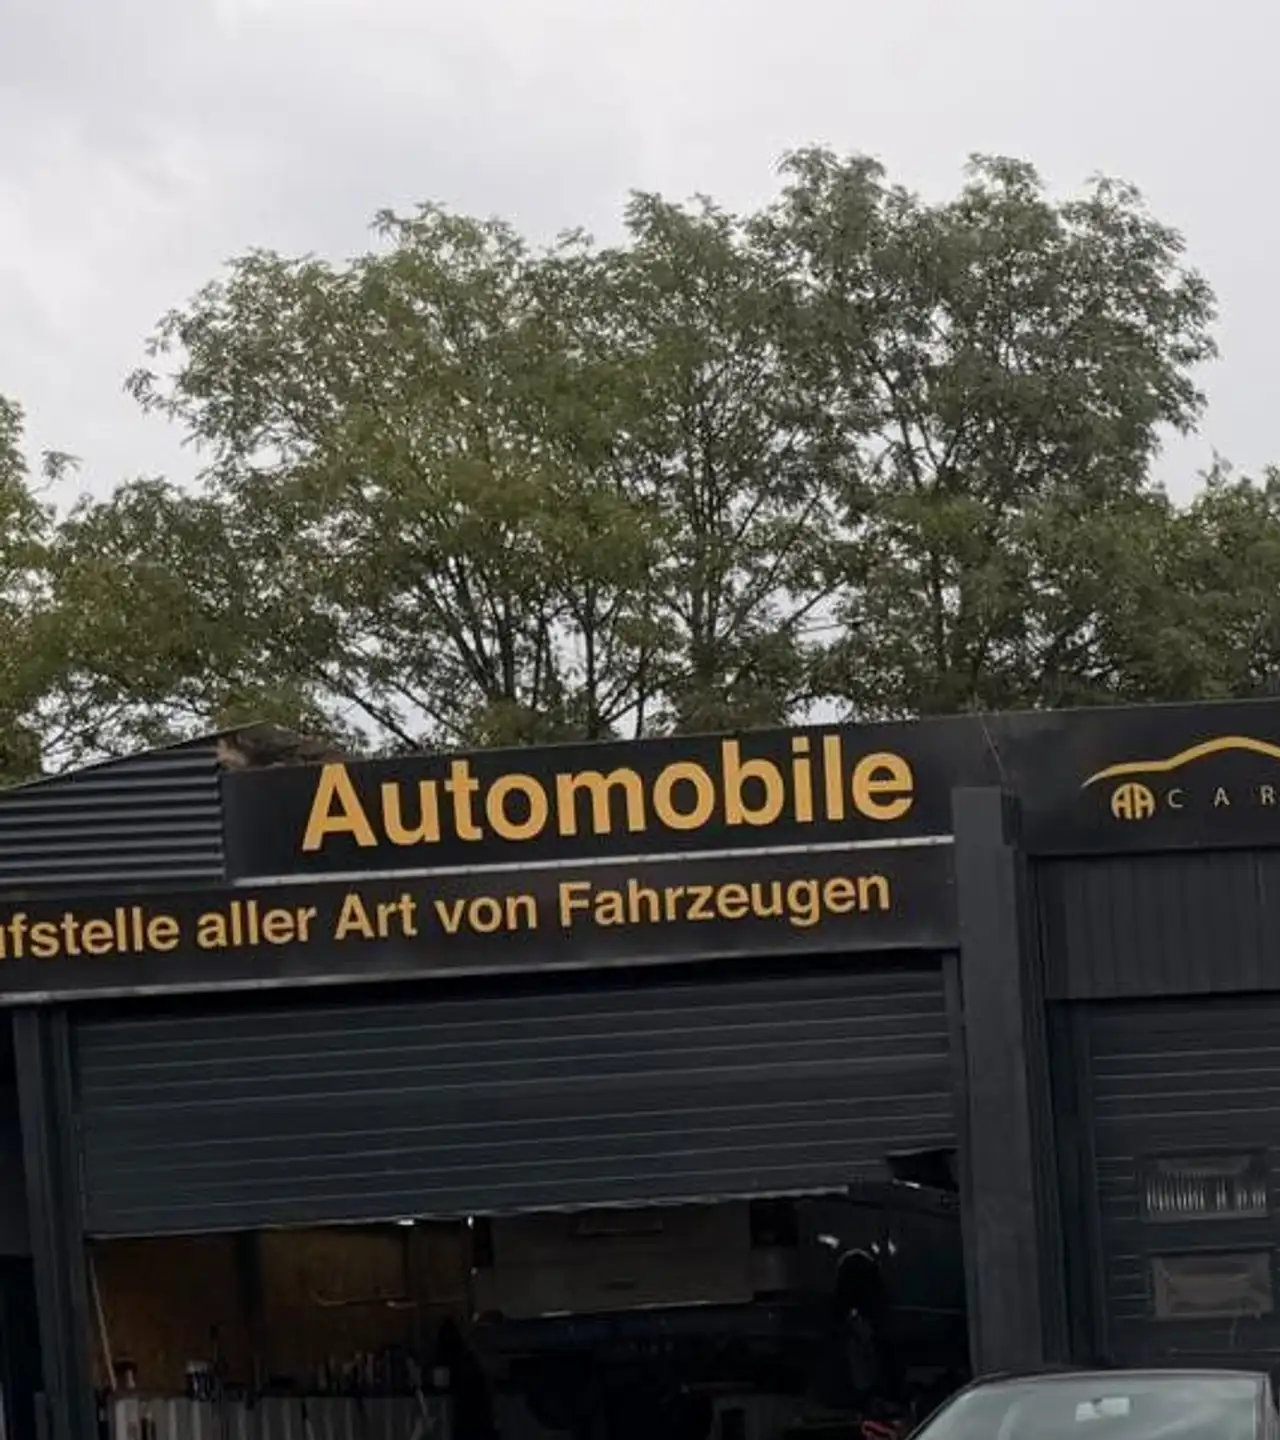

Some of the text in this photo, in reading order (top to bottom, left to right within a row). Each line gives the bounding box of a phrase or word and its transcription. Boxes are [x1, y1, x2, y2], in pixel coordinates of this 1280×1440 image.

[301, 733, 914, 852] Automobile
[0, 872, 892, 959] fstelle aller Art von Fahrzeugen
